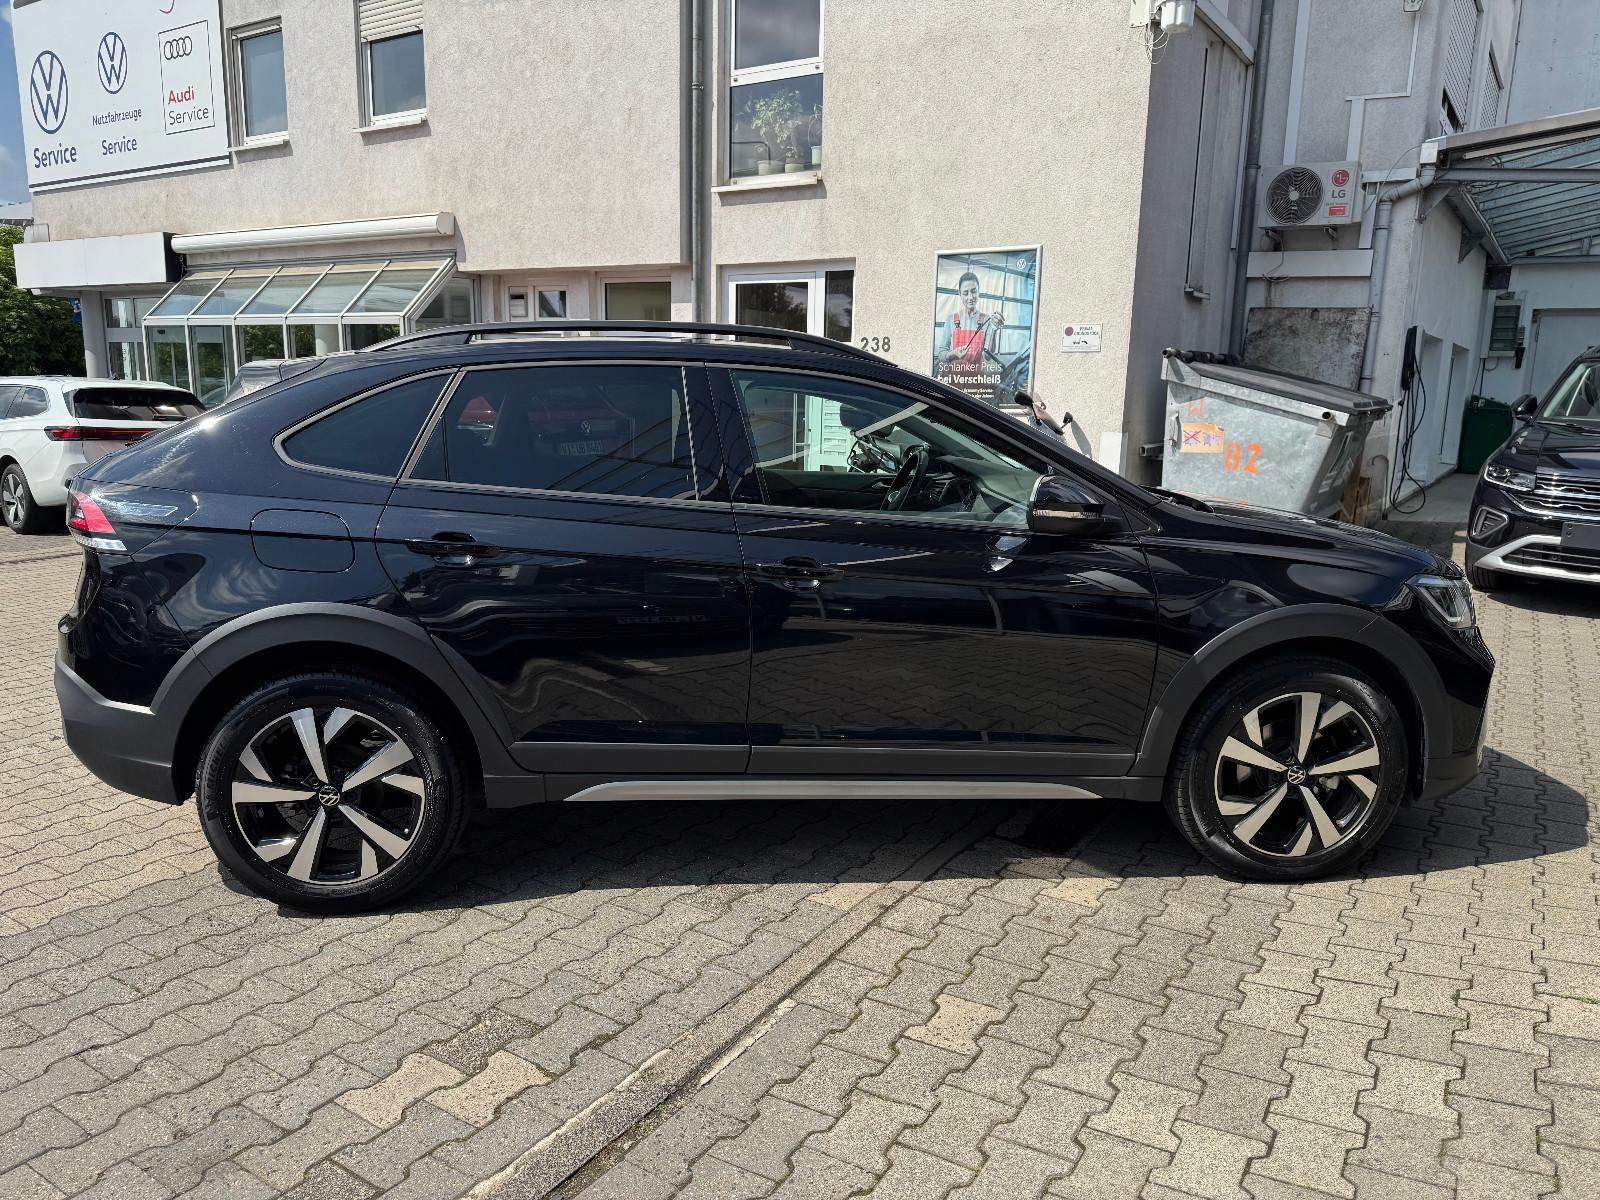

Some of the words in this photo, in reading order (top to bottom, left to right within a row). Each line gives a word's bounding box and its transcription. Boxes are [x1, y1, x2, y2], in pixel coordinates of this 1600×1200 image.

[168, 86, 196, 105] Audi
[92, 107, 142, 127] Nutzfahrzeuge
[168, 106, 210, 126] Service
[101, 135, 138, 156] Service
[33, 143, 77, 169] Service
[1331, 189, 1346, 198] LG
[860, 336, 891, 353] 238
[938, 361, 979, 372] Schlanker
[981, 361, 1002, 372] Preis
[937, 374, 952, 384] bei
[953, 374, 1001, 384] Verschleiß
